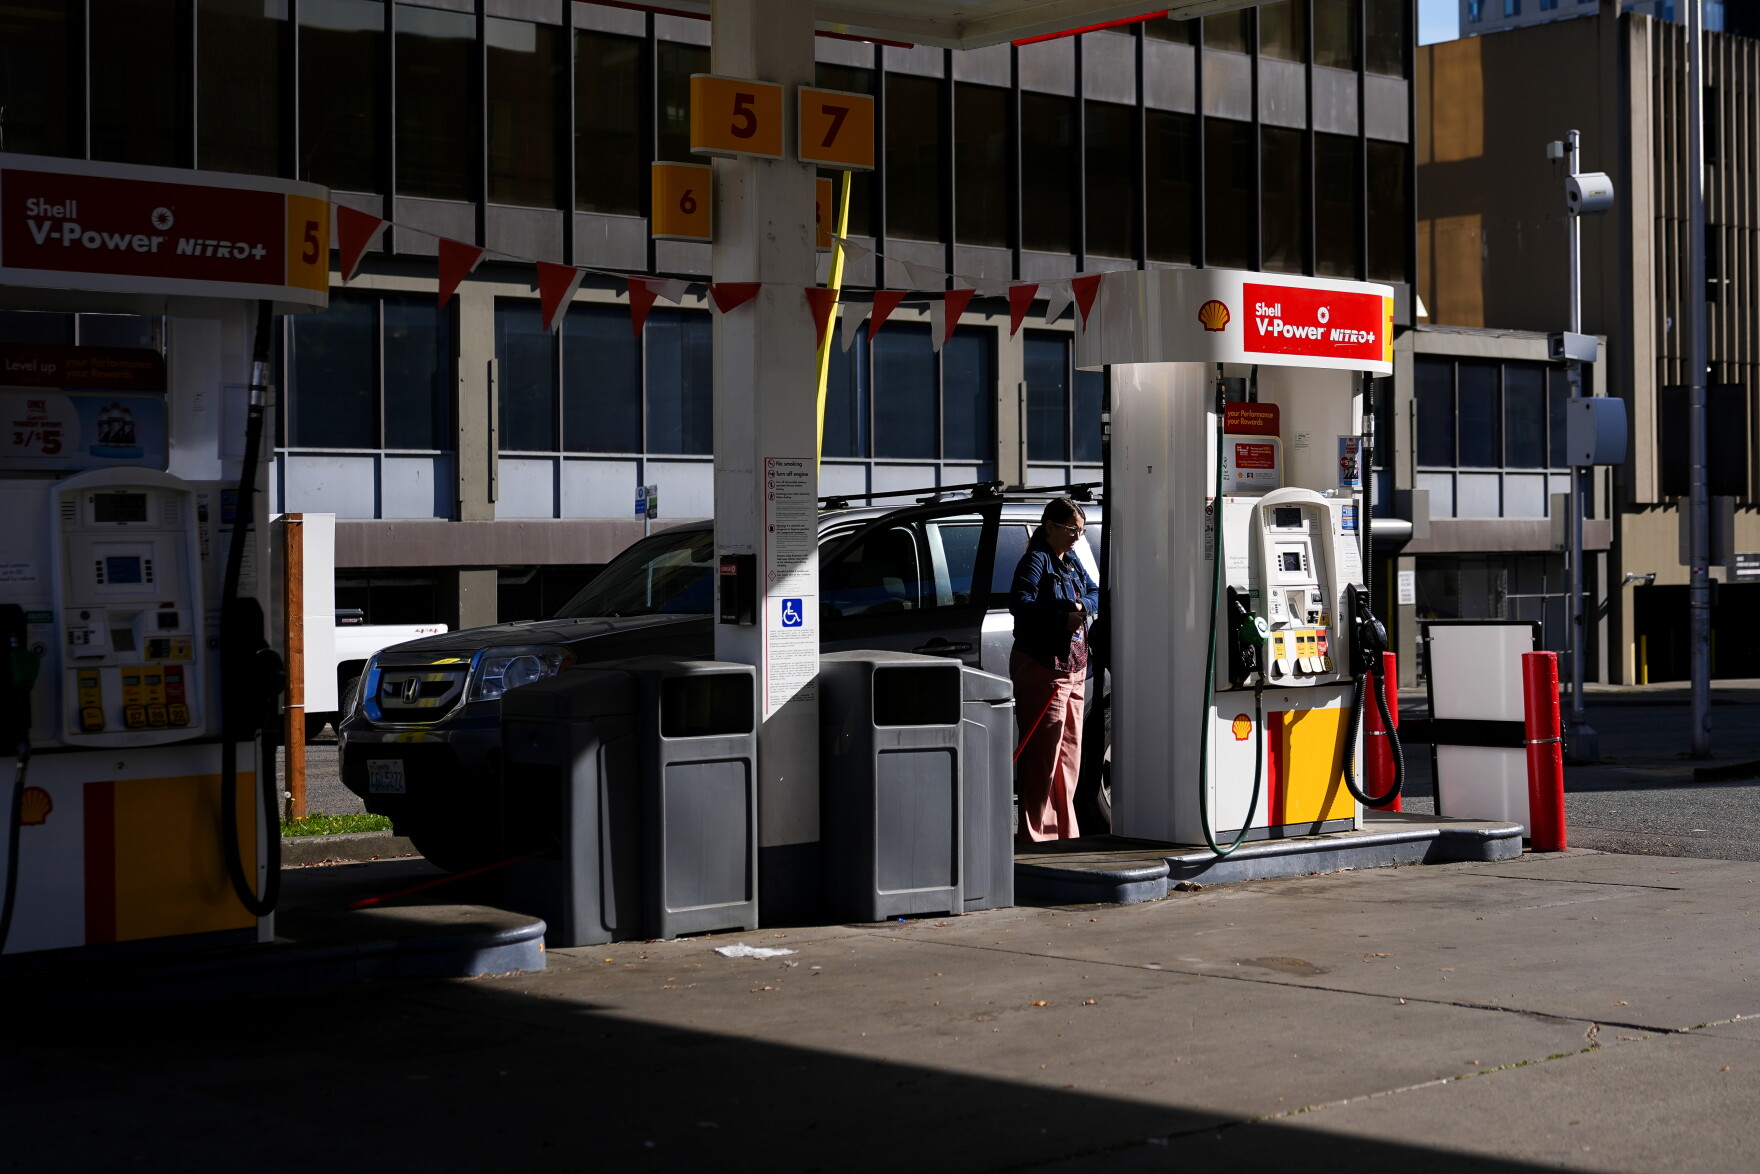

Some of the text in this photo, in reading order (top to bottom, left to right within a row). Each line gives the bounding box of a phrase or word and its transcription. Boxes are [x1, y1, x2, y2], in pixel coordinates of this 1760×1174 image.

[731, 93, 757, 138] 5
[821, 104, 850, 148] 7
[26, 198, 77, 219] Shell
[680, 190, 697, 214] 6
[26, 219, 165, 253] V-Power
[302, 220, 320, 265] 5
[1255, 302, 1281, 317] Shell
[1255, 318, 1326, 340] V-Power
[5, 358, 57, 375] Level up
[65, 357, 152, 369] your Performance
[65, 369, 133, 379] your Rewards
[1240, 410, 1273, 418] Performance
[1240, 418, 1263, 426] Rewards
[130, 712, 142, 720] 87
